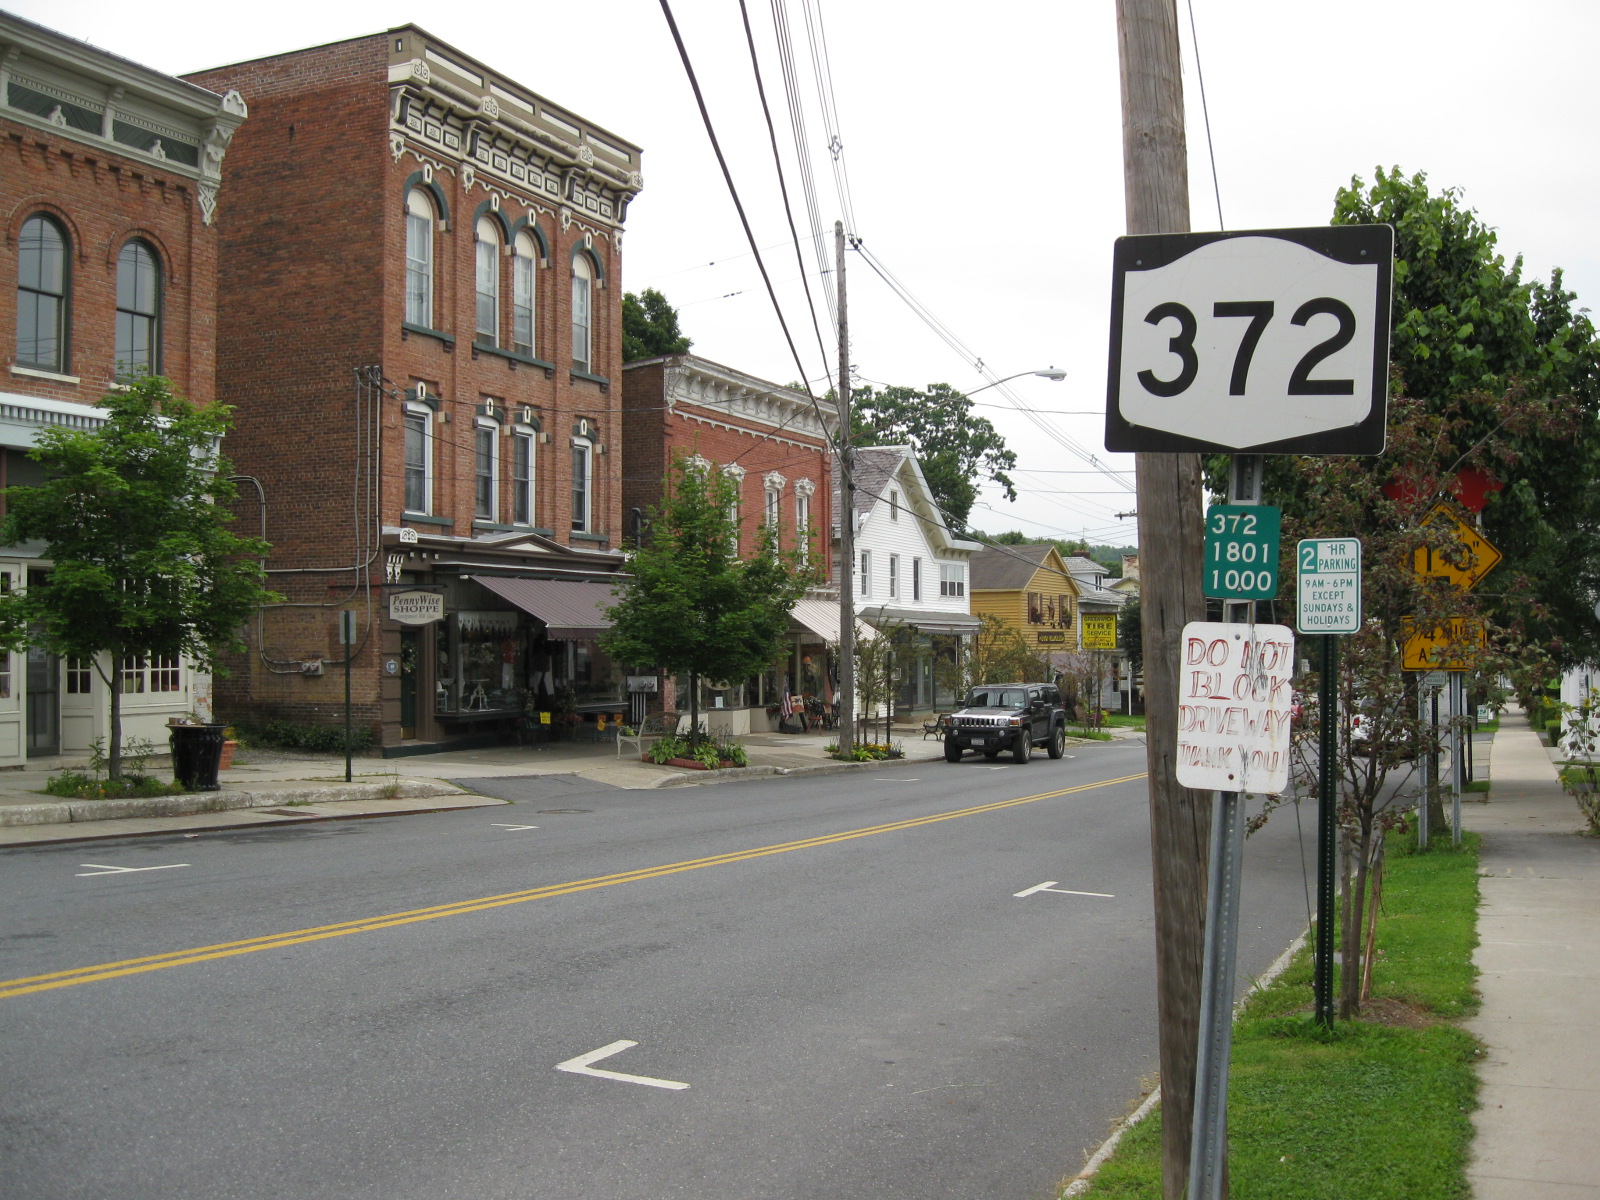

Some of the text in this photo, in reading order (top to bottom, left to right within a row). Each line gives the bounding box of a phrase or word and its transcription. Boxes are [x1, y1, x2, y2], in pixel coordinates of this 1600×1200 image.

[1137, 297, 1356, 397] 372
[1212, 514, 1257, 535] 372
[1214, 541, 1269, 563] 1801
[1302, 544, 1346, 570] 2 HR
[1319, 558, 1356, 570] PARKING
[1212, 569, 1272, 591] 1000
[1312, 591, 1345, 600] EXCEPT
[393, 605, 440, 613] SHOPPE
[1303, 603, 1354, 612] SUNDAYS &
[1307, 615, 1350, 624] HOLIDAYS
[1186, 637, 1292, 671] DO NOT
[1187, 670, 1288, 703] BLOCK
[1178, 704, 1291, 739] DRIVEWAY
